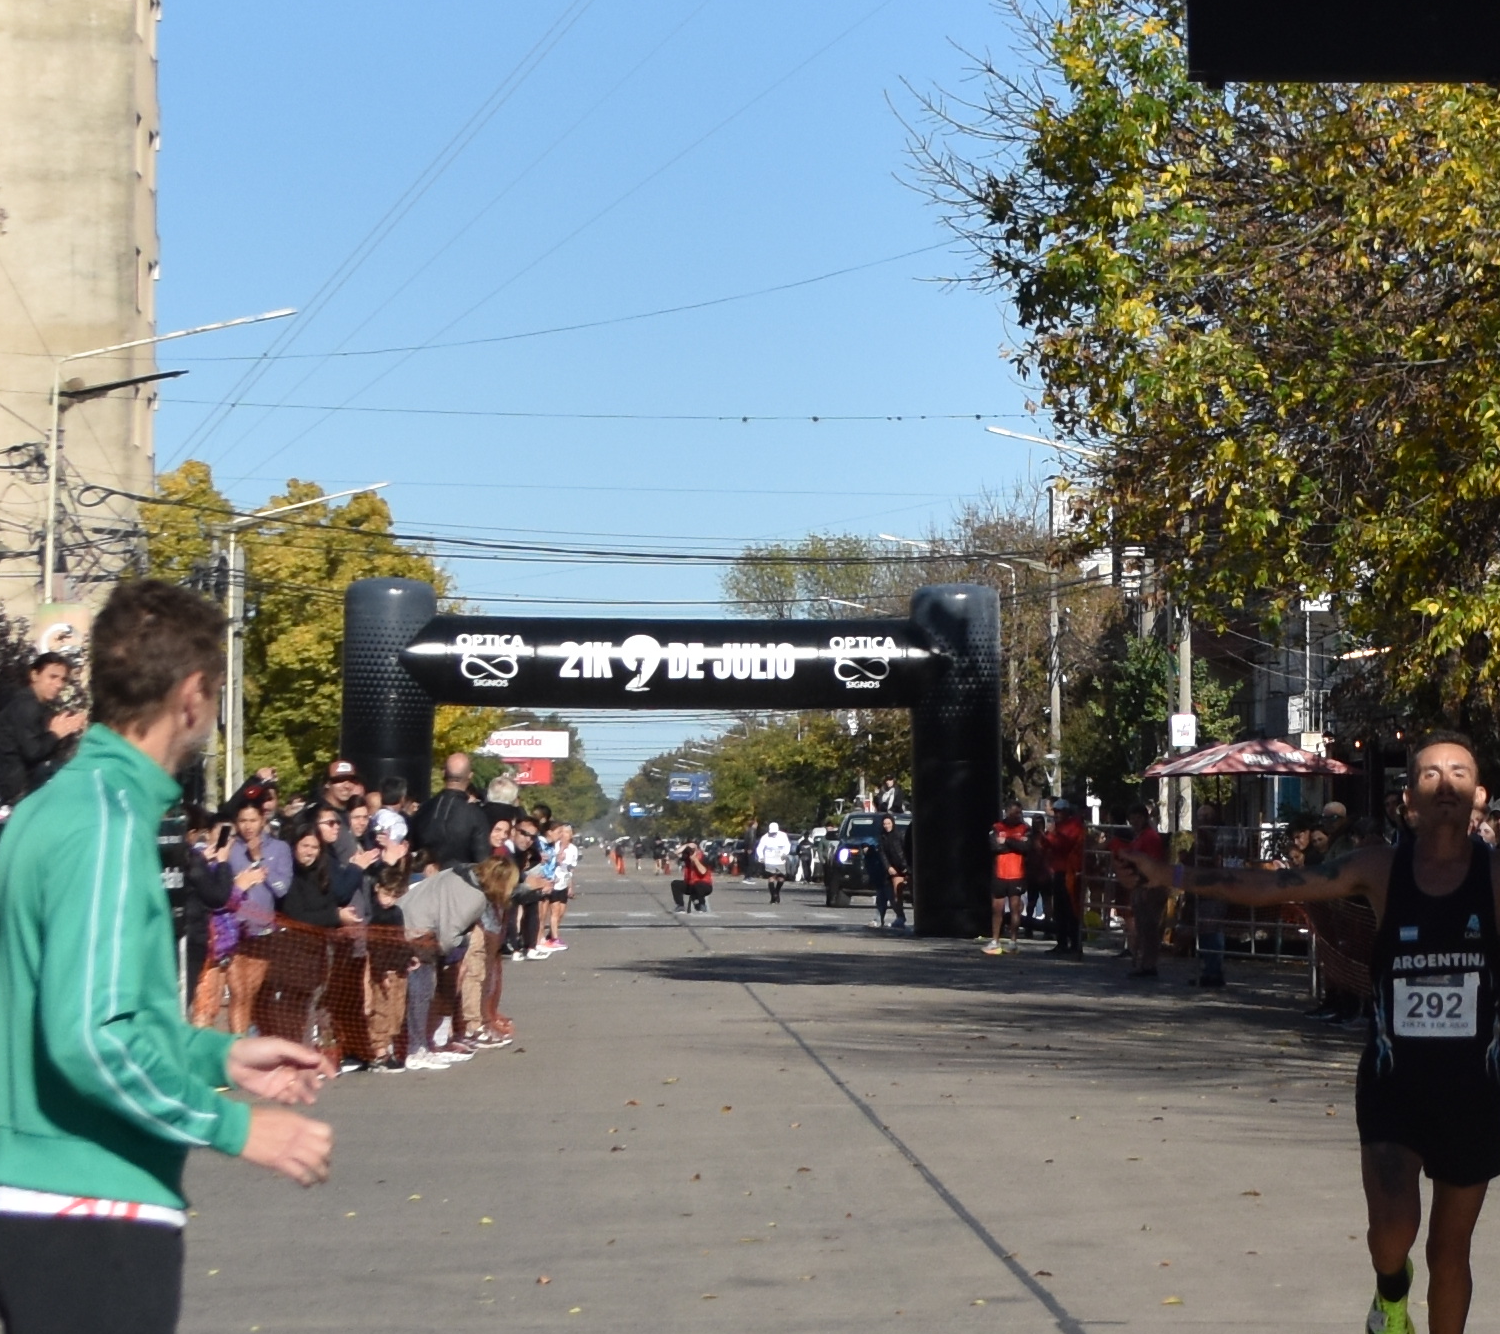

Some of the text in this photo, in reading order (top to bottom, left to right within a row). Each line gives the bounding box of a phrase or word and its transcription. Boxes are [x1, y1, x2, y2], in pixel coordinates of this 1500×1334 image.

[456, 634, 525, 652] OPTICA
[829, 636, 897, 652] OPTICA
[559, 641, 613, 678] 21K
[668, 642, 704, 679] DE
[712, 642, 796, 680] JULIO
[473, 679, 509, 687] SIGNOS
[1407, 991, 1463, 1019] 292
